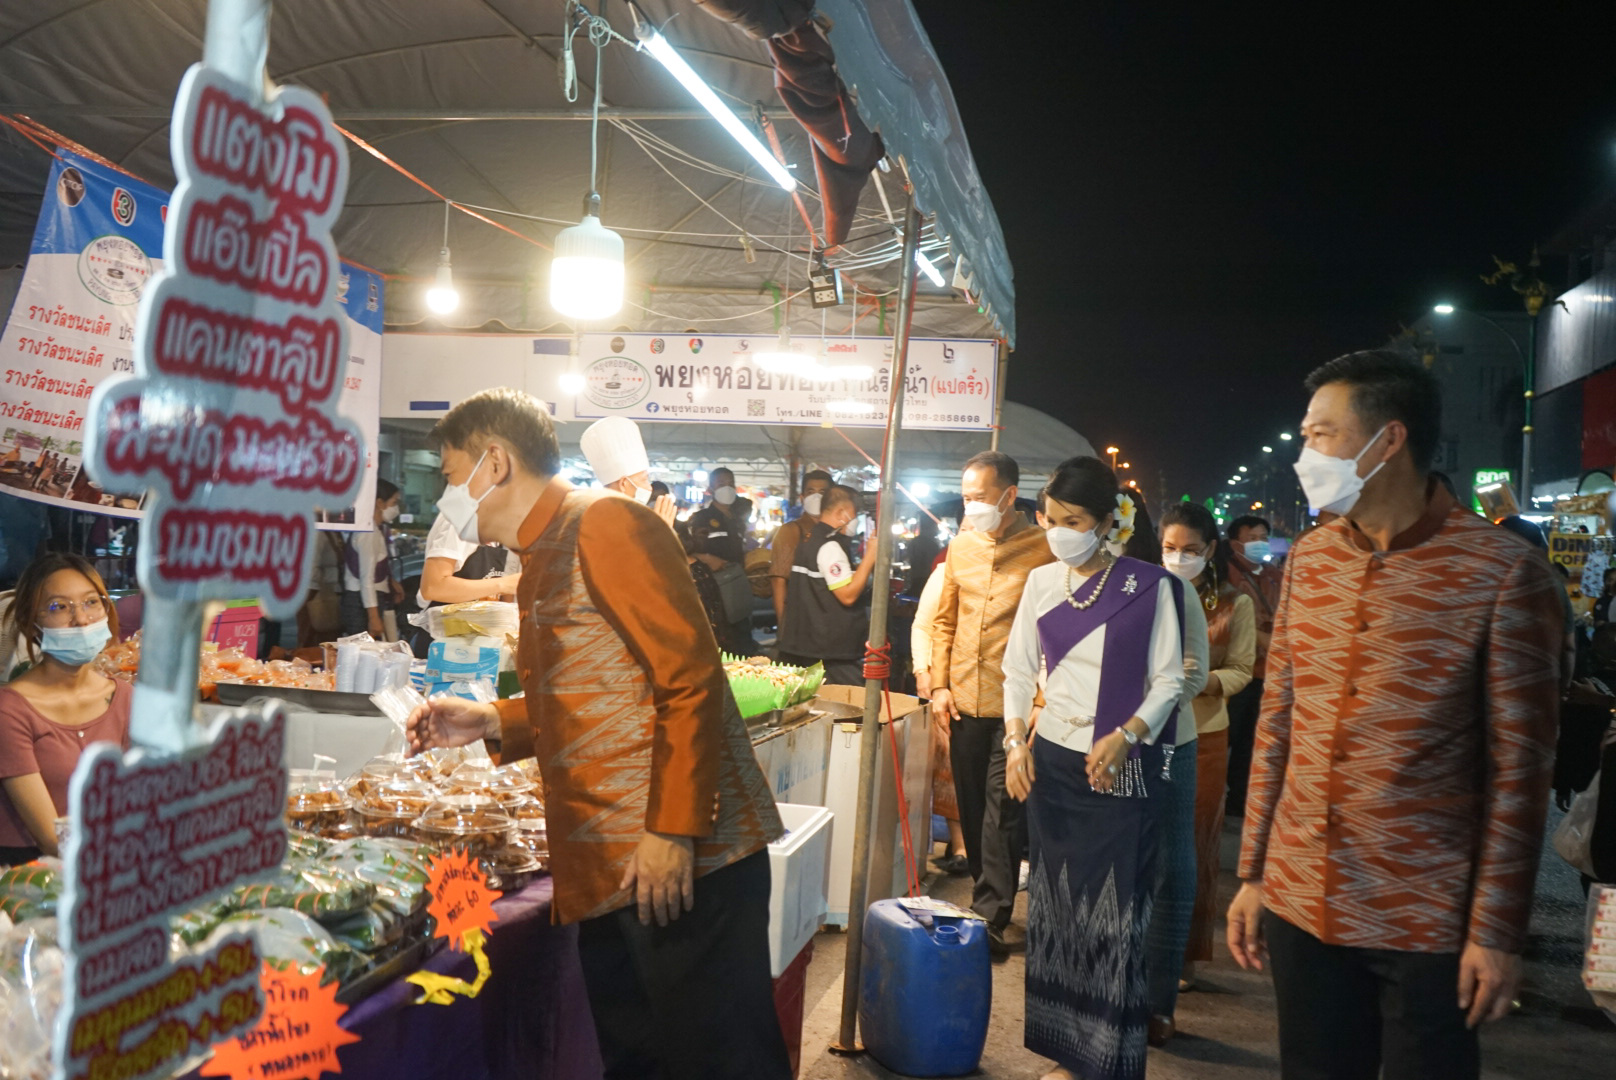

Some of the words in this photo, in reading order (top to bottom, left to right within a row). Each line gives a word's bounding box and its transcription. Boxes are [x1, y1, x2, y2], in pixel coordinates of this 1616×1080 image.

[200, 98, 332, 203] แตงโม
[29, 304, 111, 336] รางวัลชนะเลิศ
[18, 336, 104, 367] รางวัลชนะเลิศ
[5, 369, 94, 399] รางวัลชนะเลิศ
[0, 400, 83, 431] างวัลชนะเลิศ
[167, 519, 301, 588] นมชมพู
